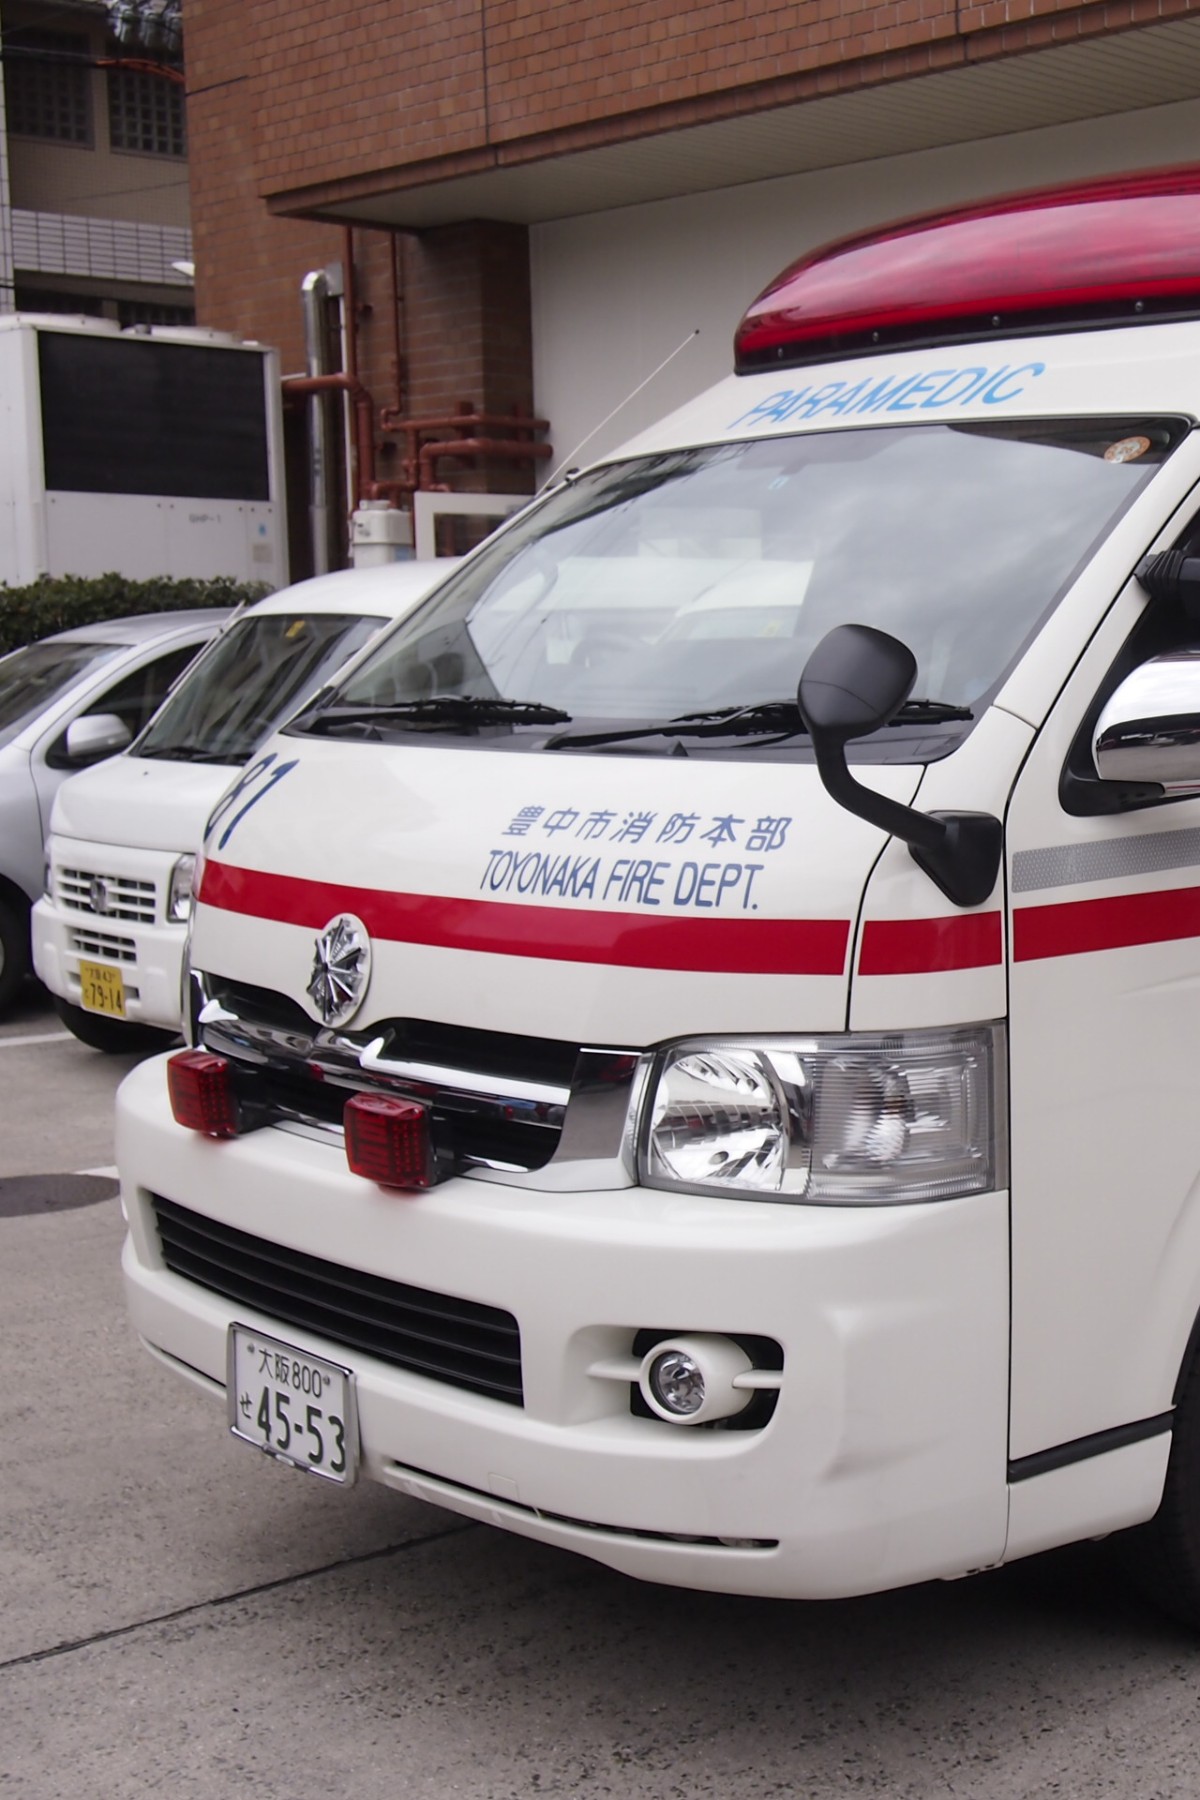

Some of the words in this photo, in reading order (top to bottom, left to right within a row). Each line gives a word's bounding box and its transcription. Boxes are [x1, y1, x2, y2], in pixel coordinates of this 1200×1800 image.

[726, 362, 1045, 430] PARAMEDIC
[501, 805, 793, 852] 豊中市消防本部
[479, 849, 601, 899] TOYONAKA
[602, 859, 671, 905] FIRE
[673, 861, 765, 910] DEPT.
[239, 1391, 253, 1419] せ
[257, 1386, 346, 1473] 45-53
